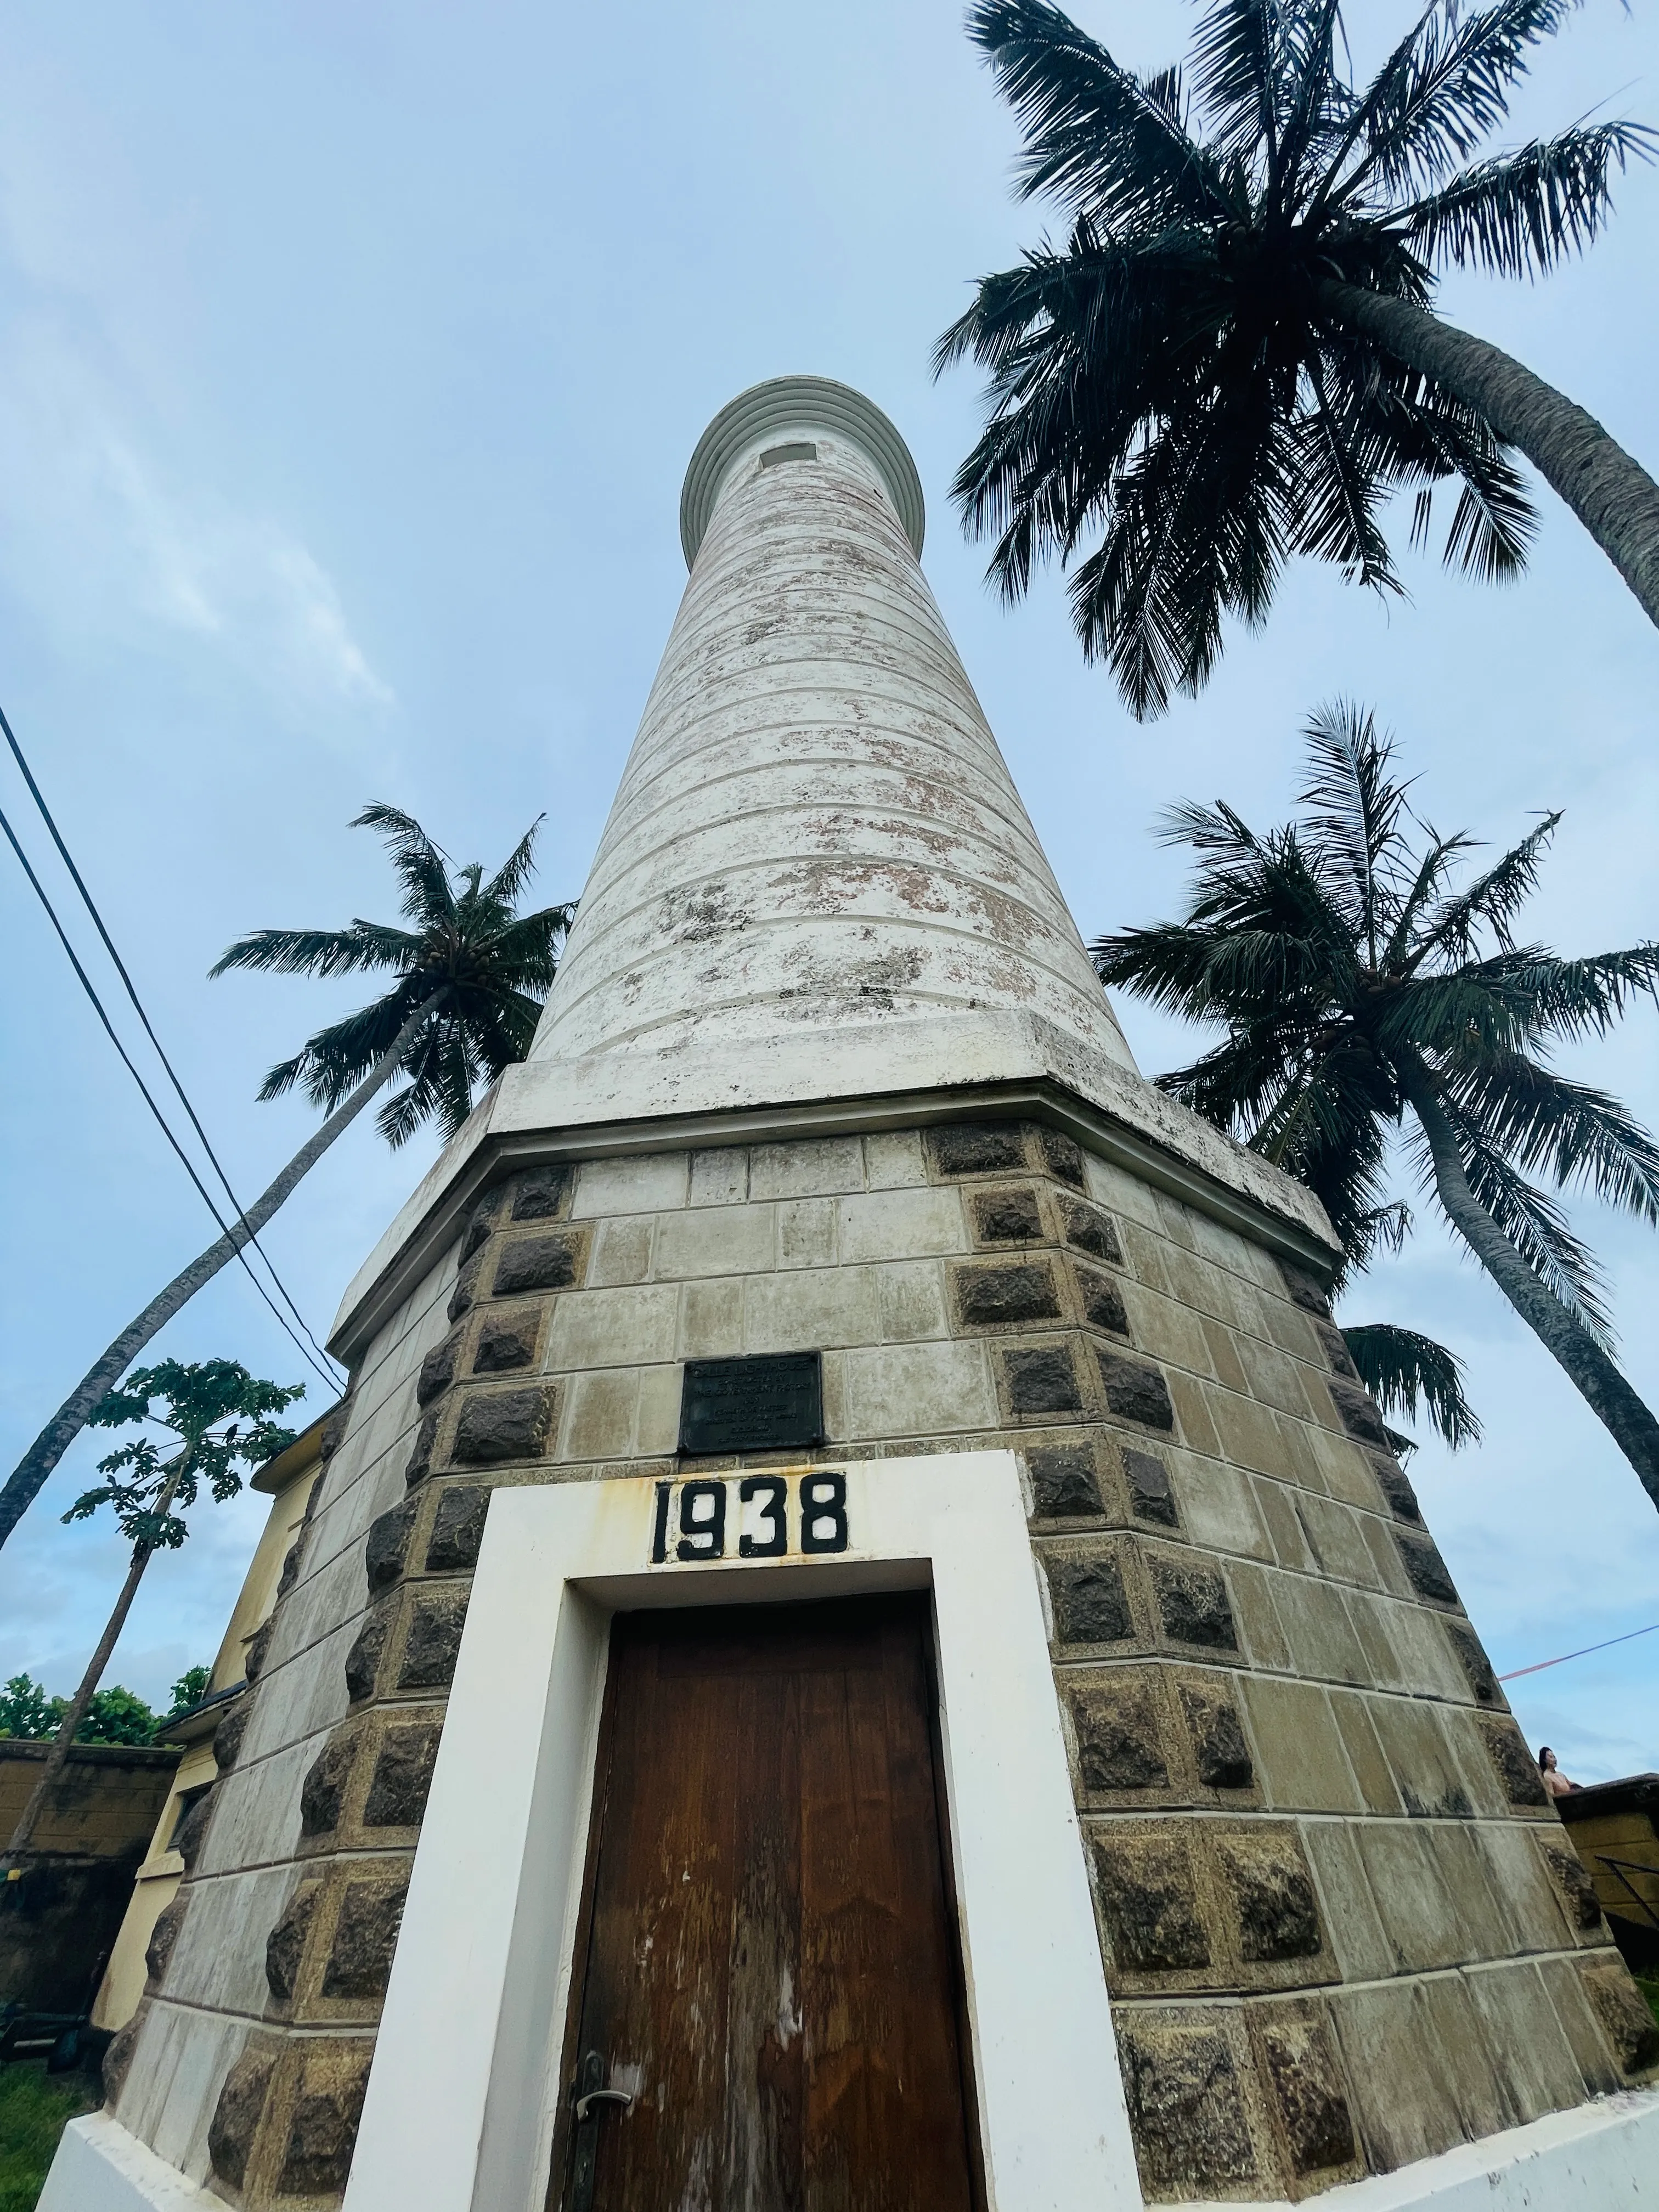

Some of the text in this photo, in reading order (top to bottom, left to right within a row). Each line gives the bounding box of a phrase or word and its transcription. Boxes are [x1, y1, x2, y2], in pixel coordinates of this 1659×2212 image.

[734, 1360, 810, 1376] LIGHTHOUSE
[776, 1373, 786, 1382] BY
[715, 1385, 774, 1397] GOVERNMENT
[653, 1472, 848, 1564] 1938
